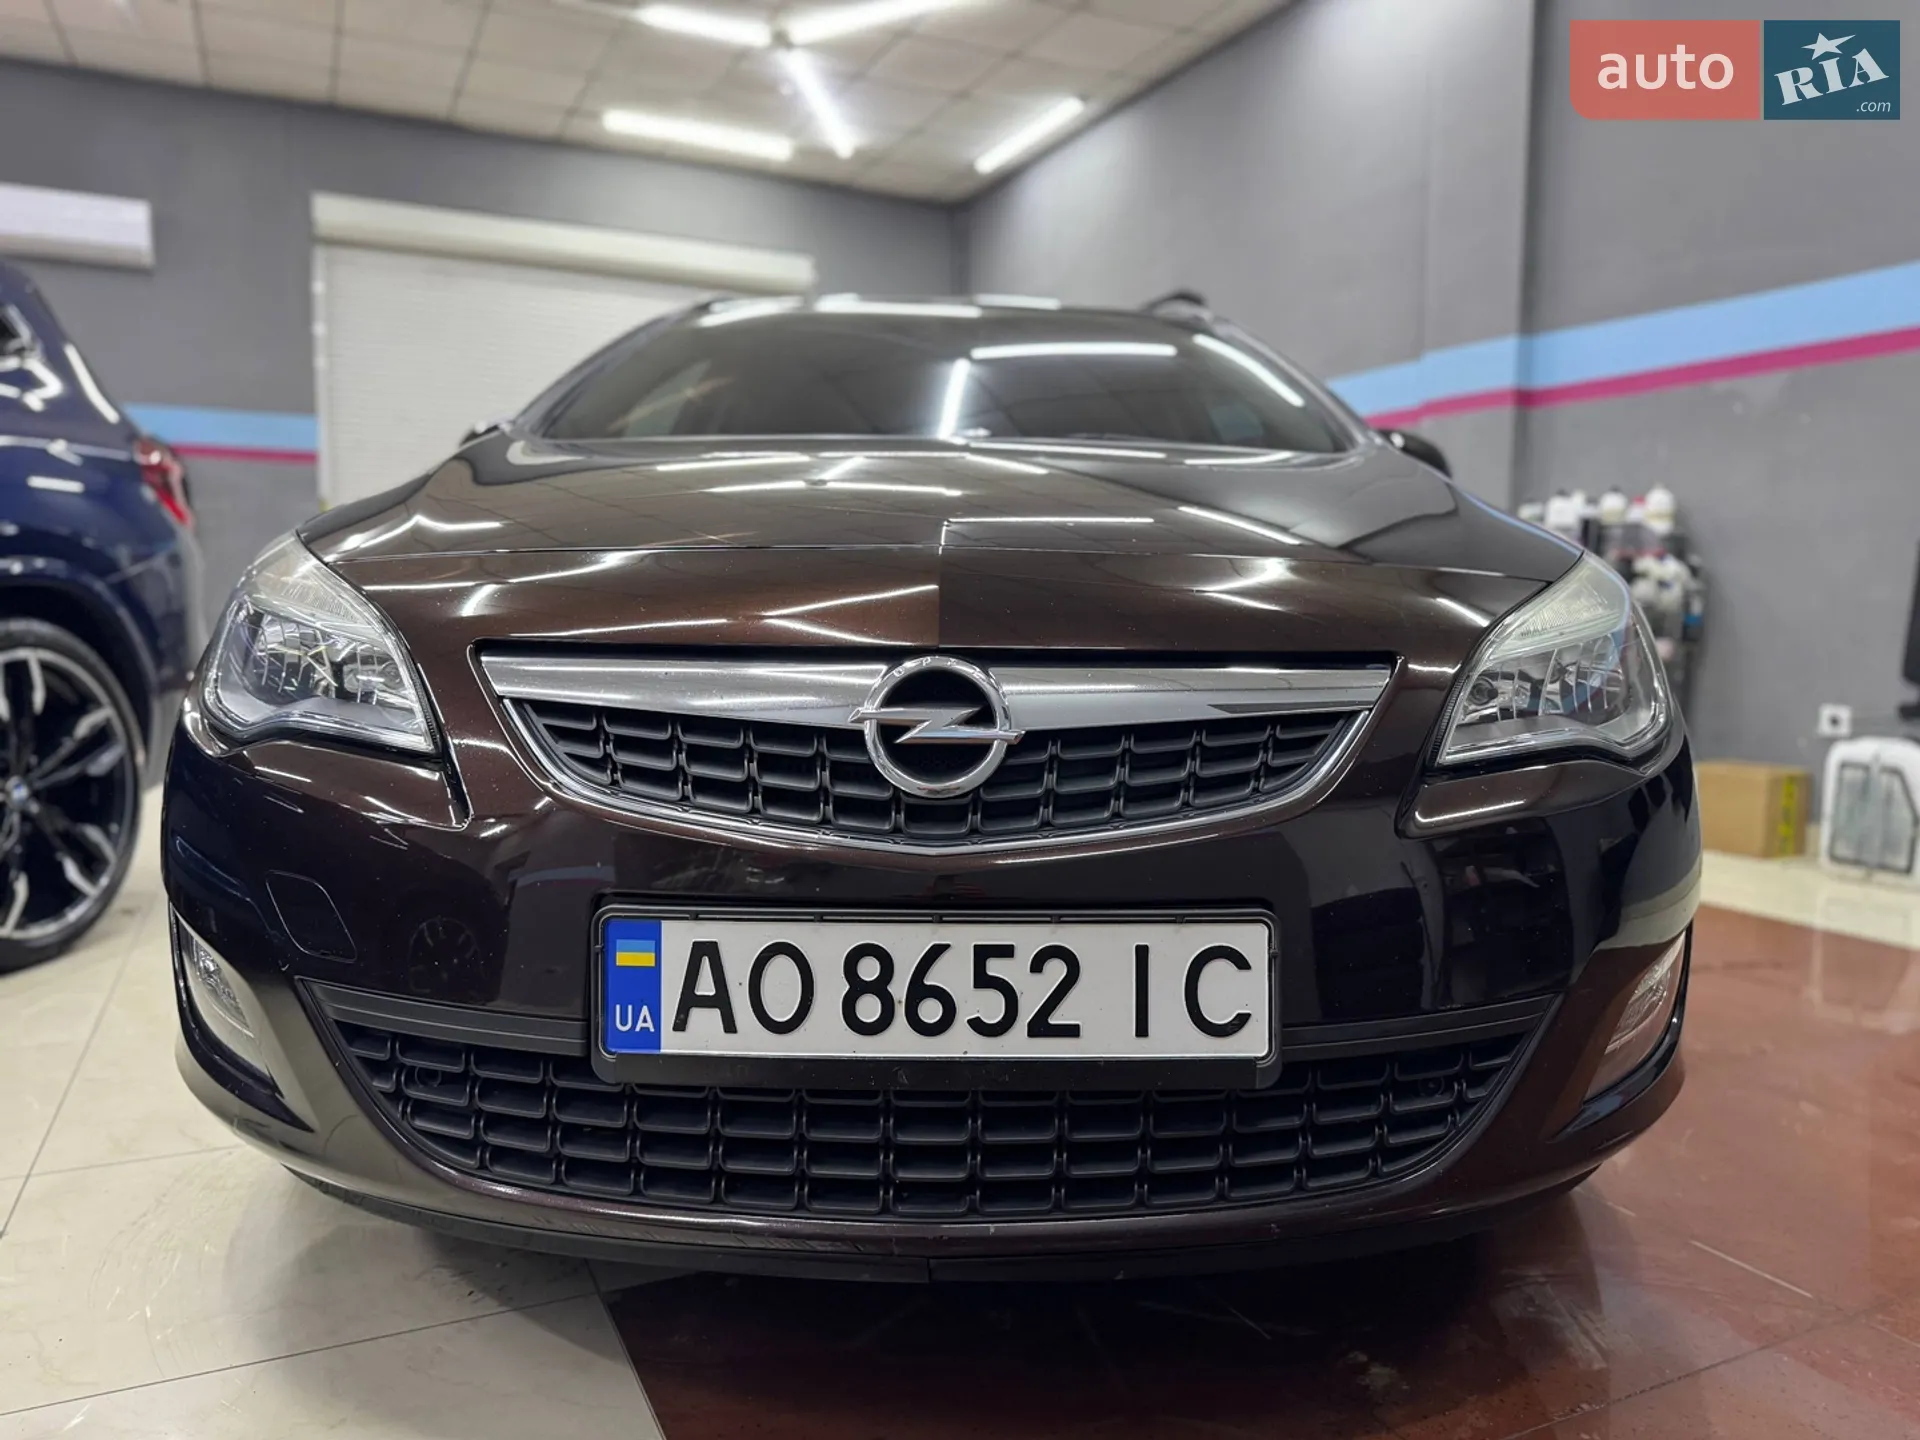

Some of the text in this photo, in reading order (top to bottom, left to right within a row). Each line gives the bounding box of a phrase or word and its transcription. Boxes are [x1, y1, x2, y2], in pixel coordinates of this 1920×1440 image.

[615, 1004, 655, 1033] UA
[671, 940, 1252, 1039] AO 8652 IC
